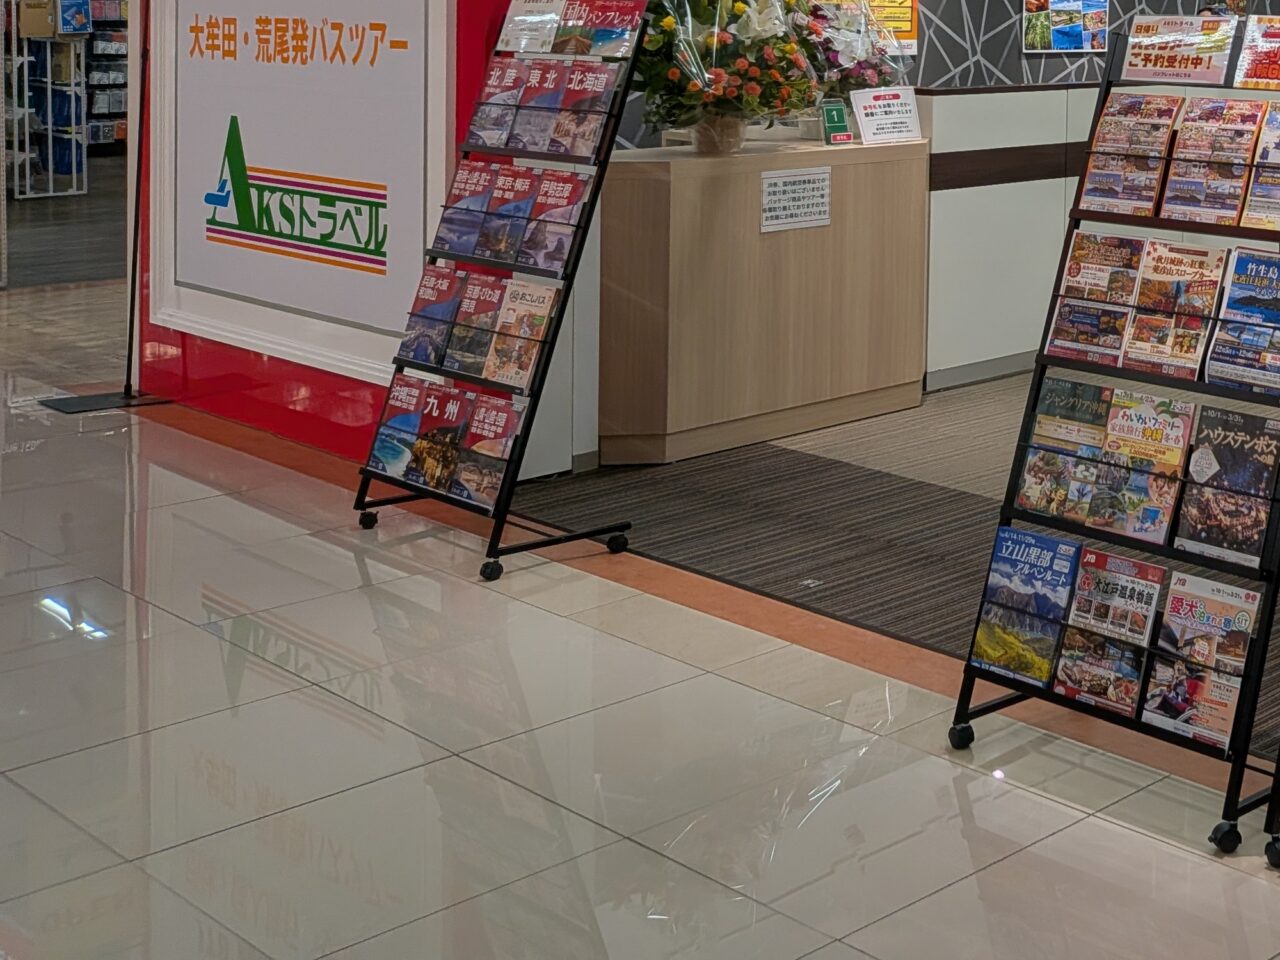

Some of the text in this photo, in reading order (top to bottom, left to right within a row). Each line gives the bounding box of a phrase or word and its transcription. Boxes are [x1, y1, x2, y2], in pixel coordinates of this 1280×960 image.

[189, 13, 410, 68] 大牟田・荒尾発バスツアー
[1134, 24, 1159, 35] 日帰り
[1128, 52, 1213, 70] ご予約受付中!
[526, 69, 559, 89] 東北
[567, 70, 609, 92] 北海道
[831, 110, 838, 122] 1
[205, 114, 389, 260] AKSトラベル
[423, 395, 460, 422] 九州
[1198, 425, 1278, 455] ハウステンボス
[997, 540, 1054, 568] 立山黒部
[1014, 561, 1066, 585] アルペンルート
